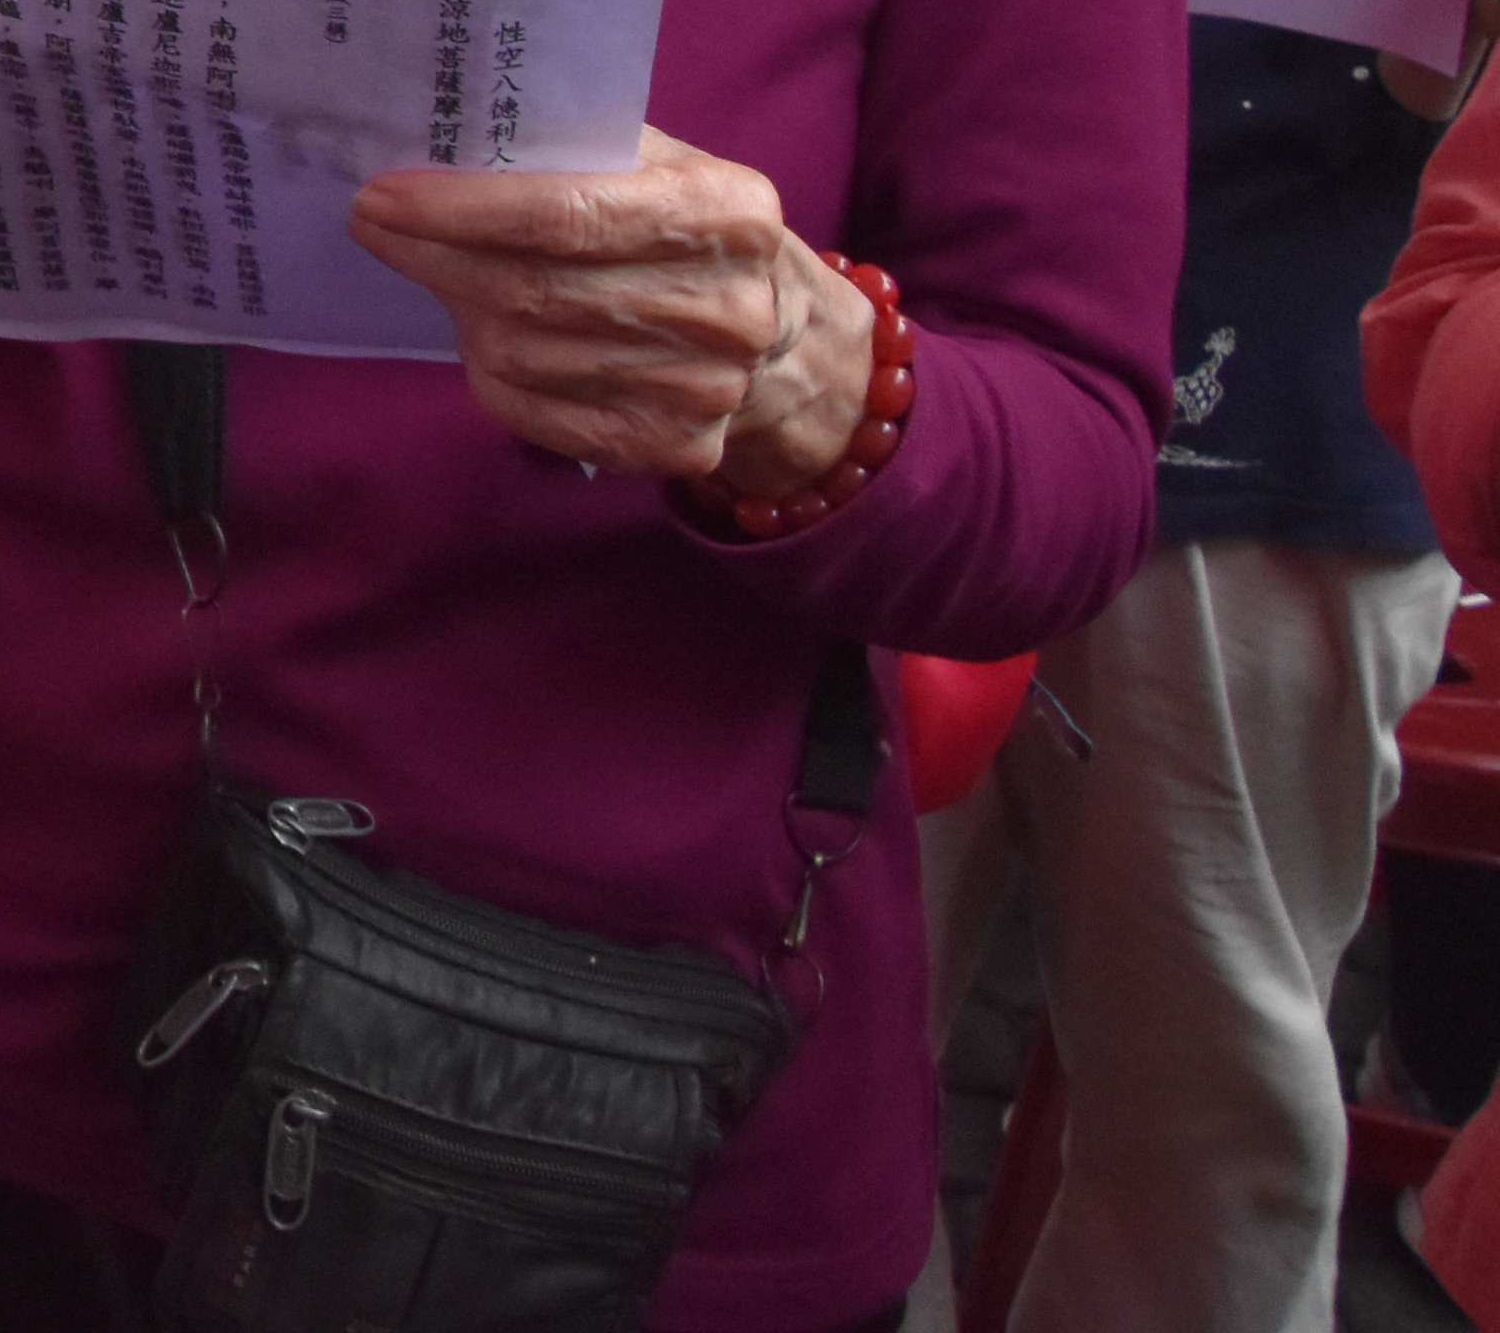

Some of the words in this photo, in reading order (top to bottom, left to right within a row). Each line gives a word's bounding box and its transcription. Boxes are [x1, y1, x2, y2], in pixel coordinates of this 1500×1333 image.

[483, 20, 527, 173] 性空八德利人
